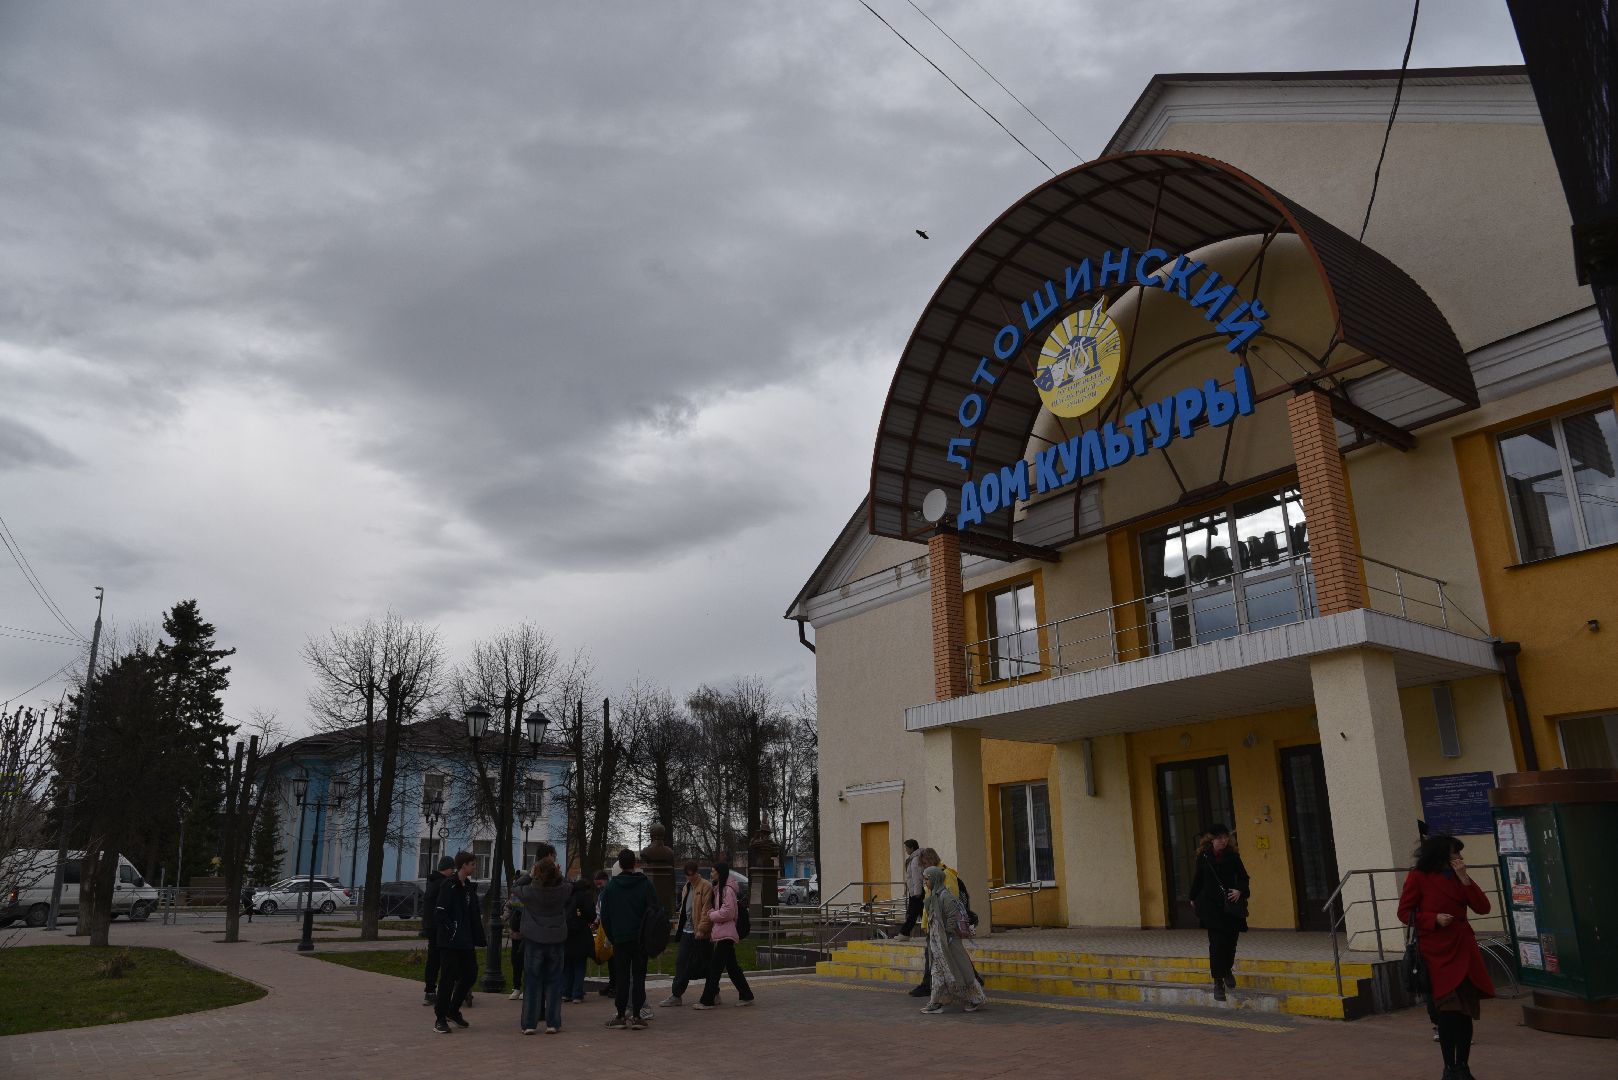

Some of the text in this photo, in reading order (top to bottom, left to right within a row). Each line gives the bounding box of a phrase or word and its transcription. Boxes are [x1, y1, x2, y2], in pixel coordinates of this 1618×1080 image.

[946, 247, 1270, 470] ЛОТОШИНСКИЙ
[957, 366, 1255, 530] ДОМ КУЛЬТУРЫ
